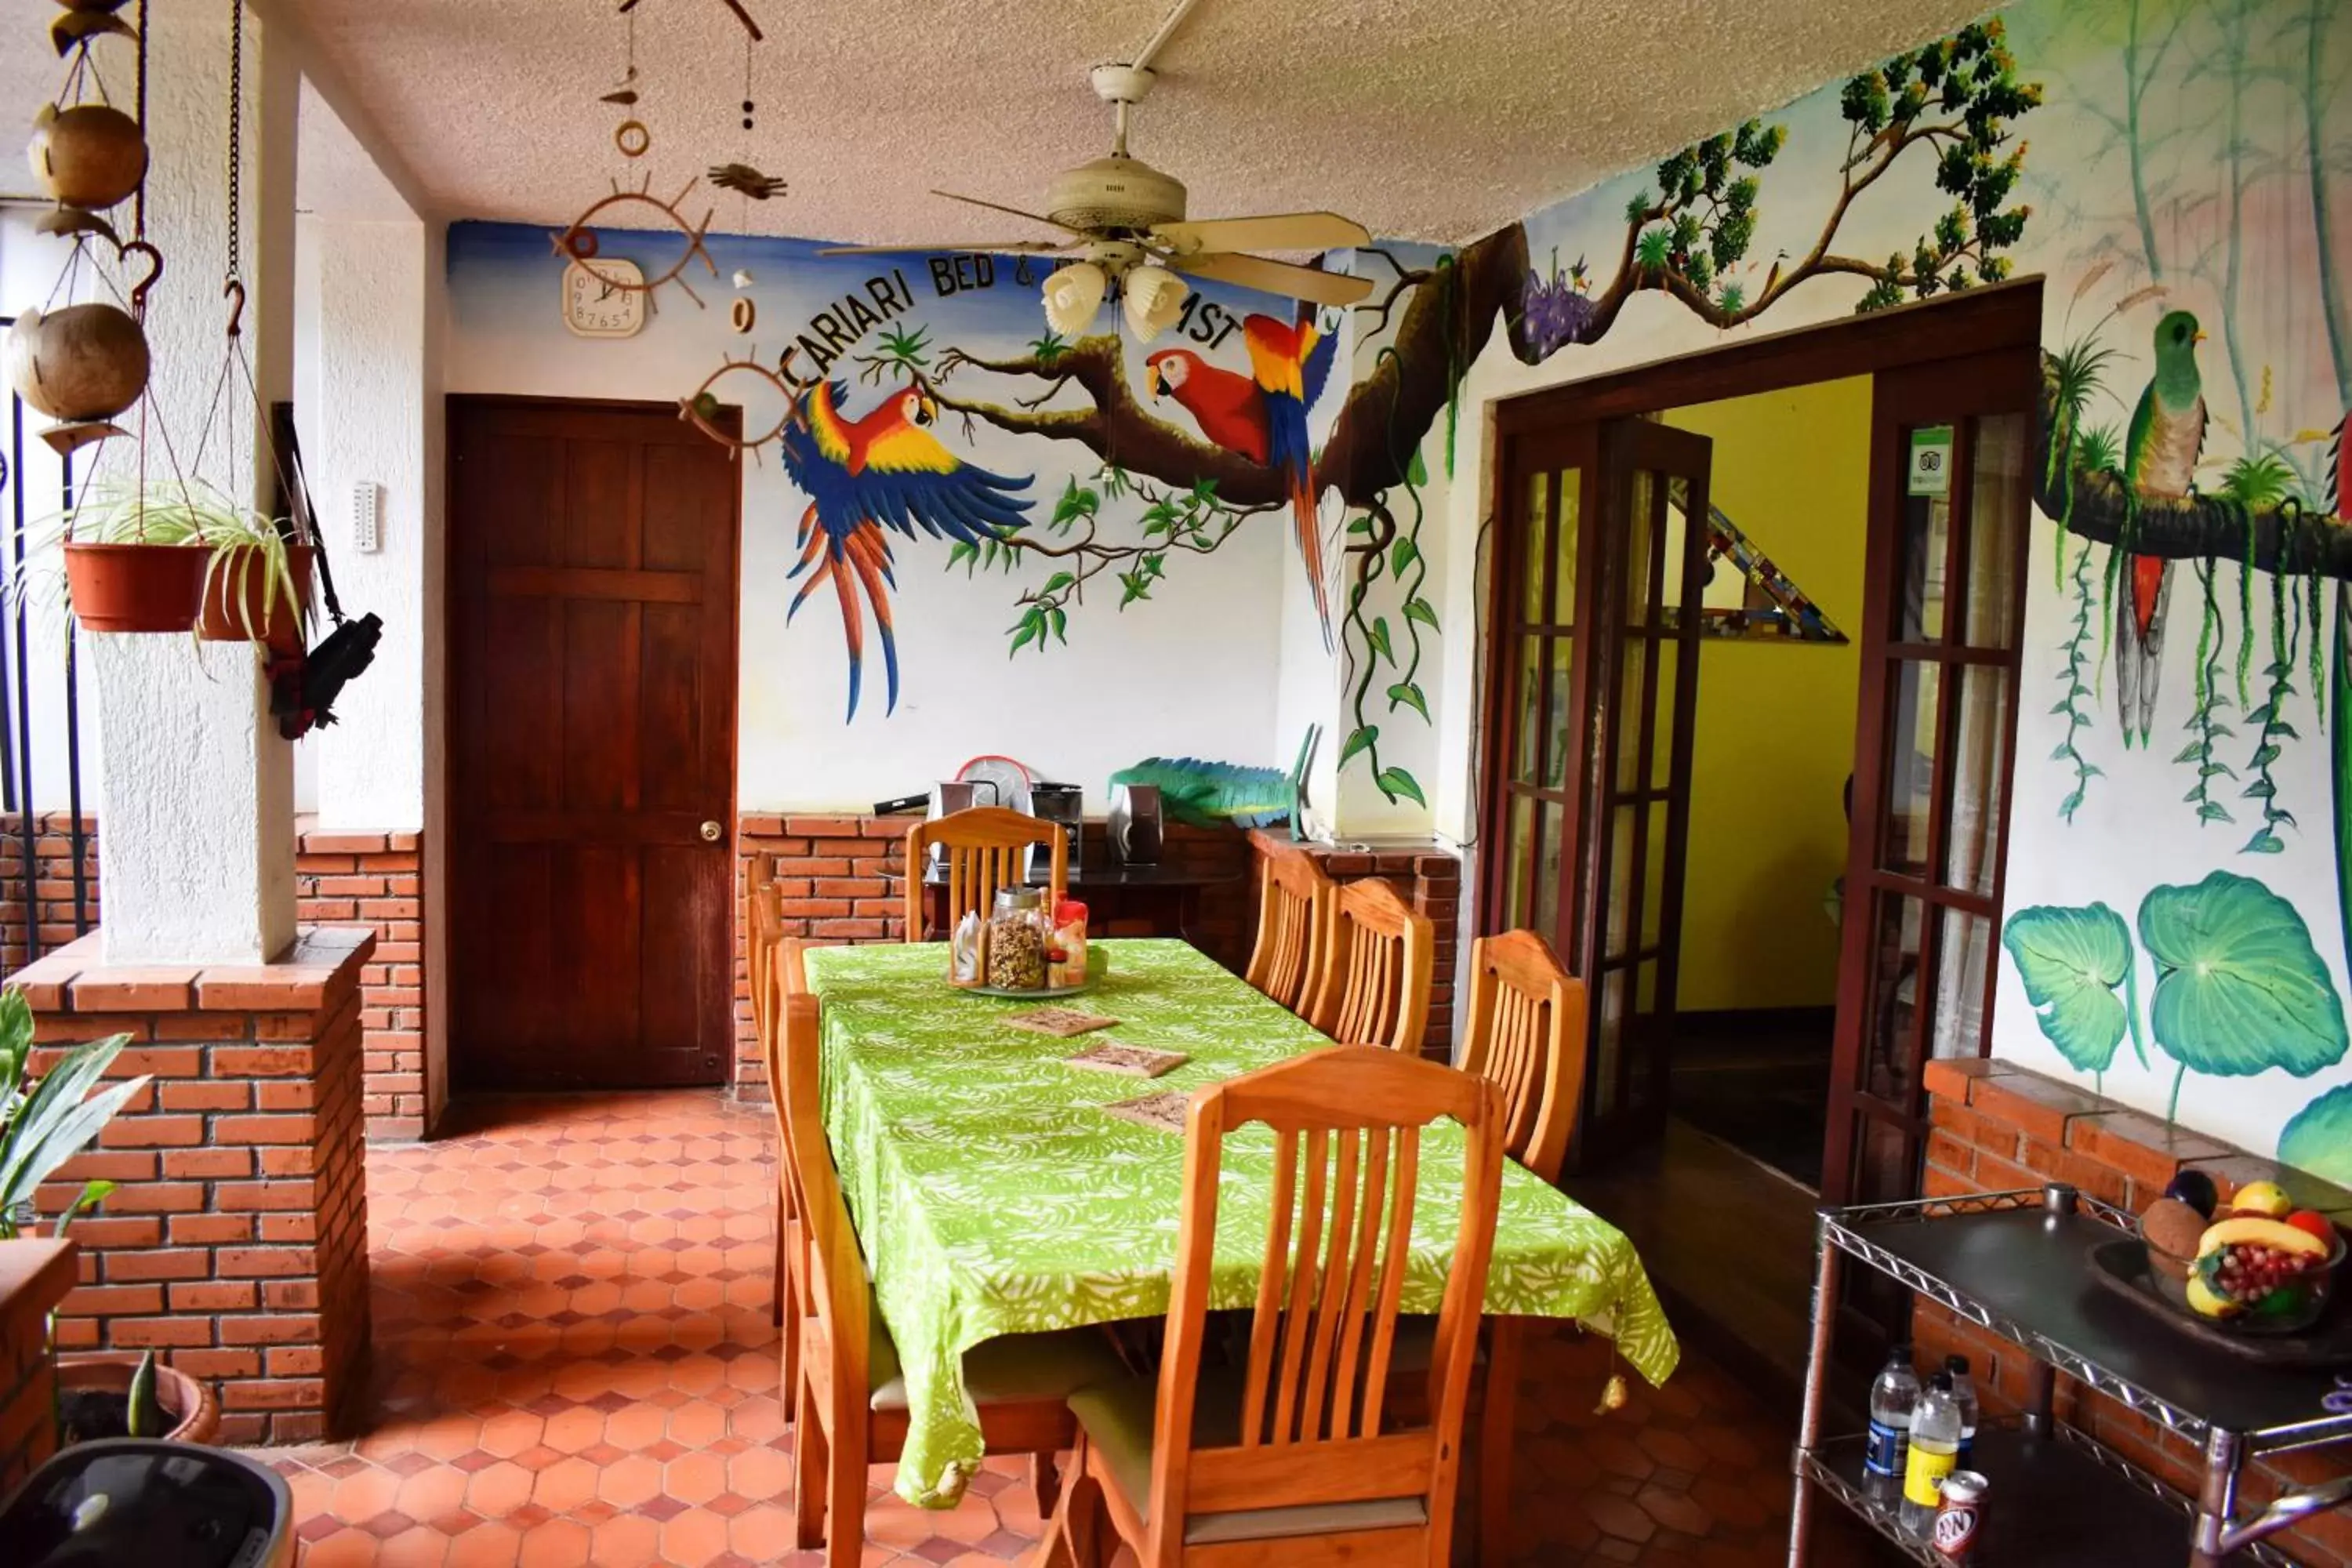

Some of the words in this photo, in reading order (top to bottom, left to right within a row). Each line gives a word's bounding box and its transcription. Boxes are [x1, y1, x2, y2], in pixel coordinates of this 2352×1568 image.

[574, 291, 583, 303] 9
[588, 312, 596, 325] 7
[600, 314, 608, 327] 6
[611, 314, 621, 327] 5
[779, 269, 915, 389] CARIARI
[928, 255, 995, 297] BED
[1015, 254, 1033, 288] &
